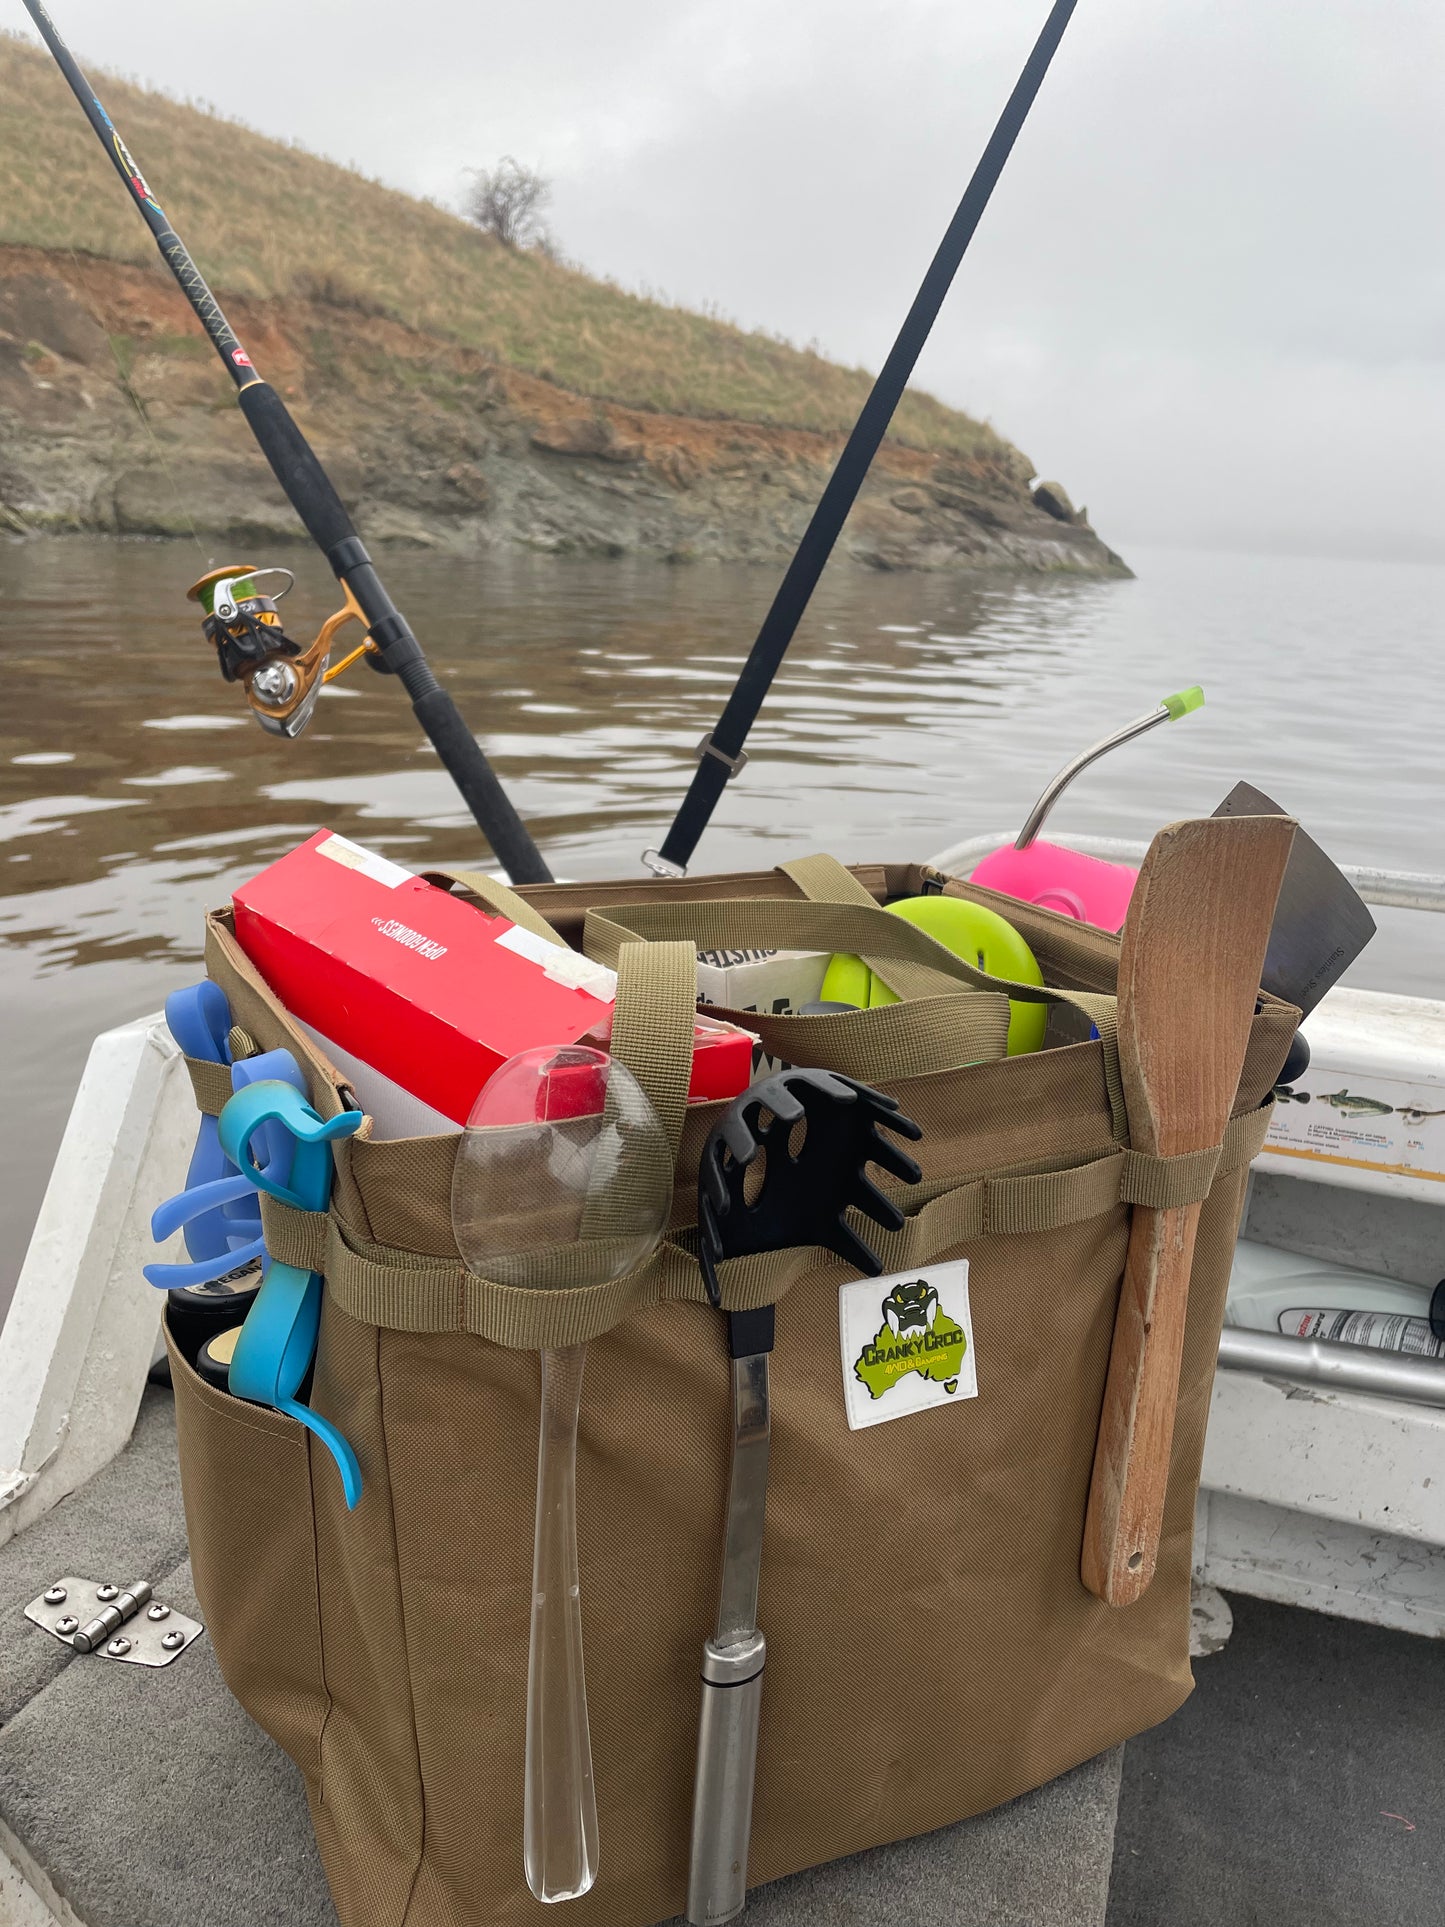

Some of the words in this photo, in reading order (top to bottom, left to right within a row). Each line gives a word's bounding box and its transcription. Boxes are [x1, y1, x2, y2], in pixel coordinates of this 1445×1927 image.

[377, 919, 428, 949] GOODNESS
[414, 939, 448, 960] OPEN
[1314, 946, 1345, 980] Stainless
[1298, 979, 1318, 1000] Steel
[863, 1339, 924, 1367] CRANKY
[923, 1330, 964, 1352] CROC
[884, 1360, 907, 1376] 4WD
[907, 1357, 916, 1370] &
